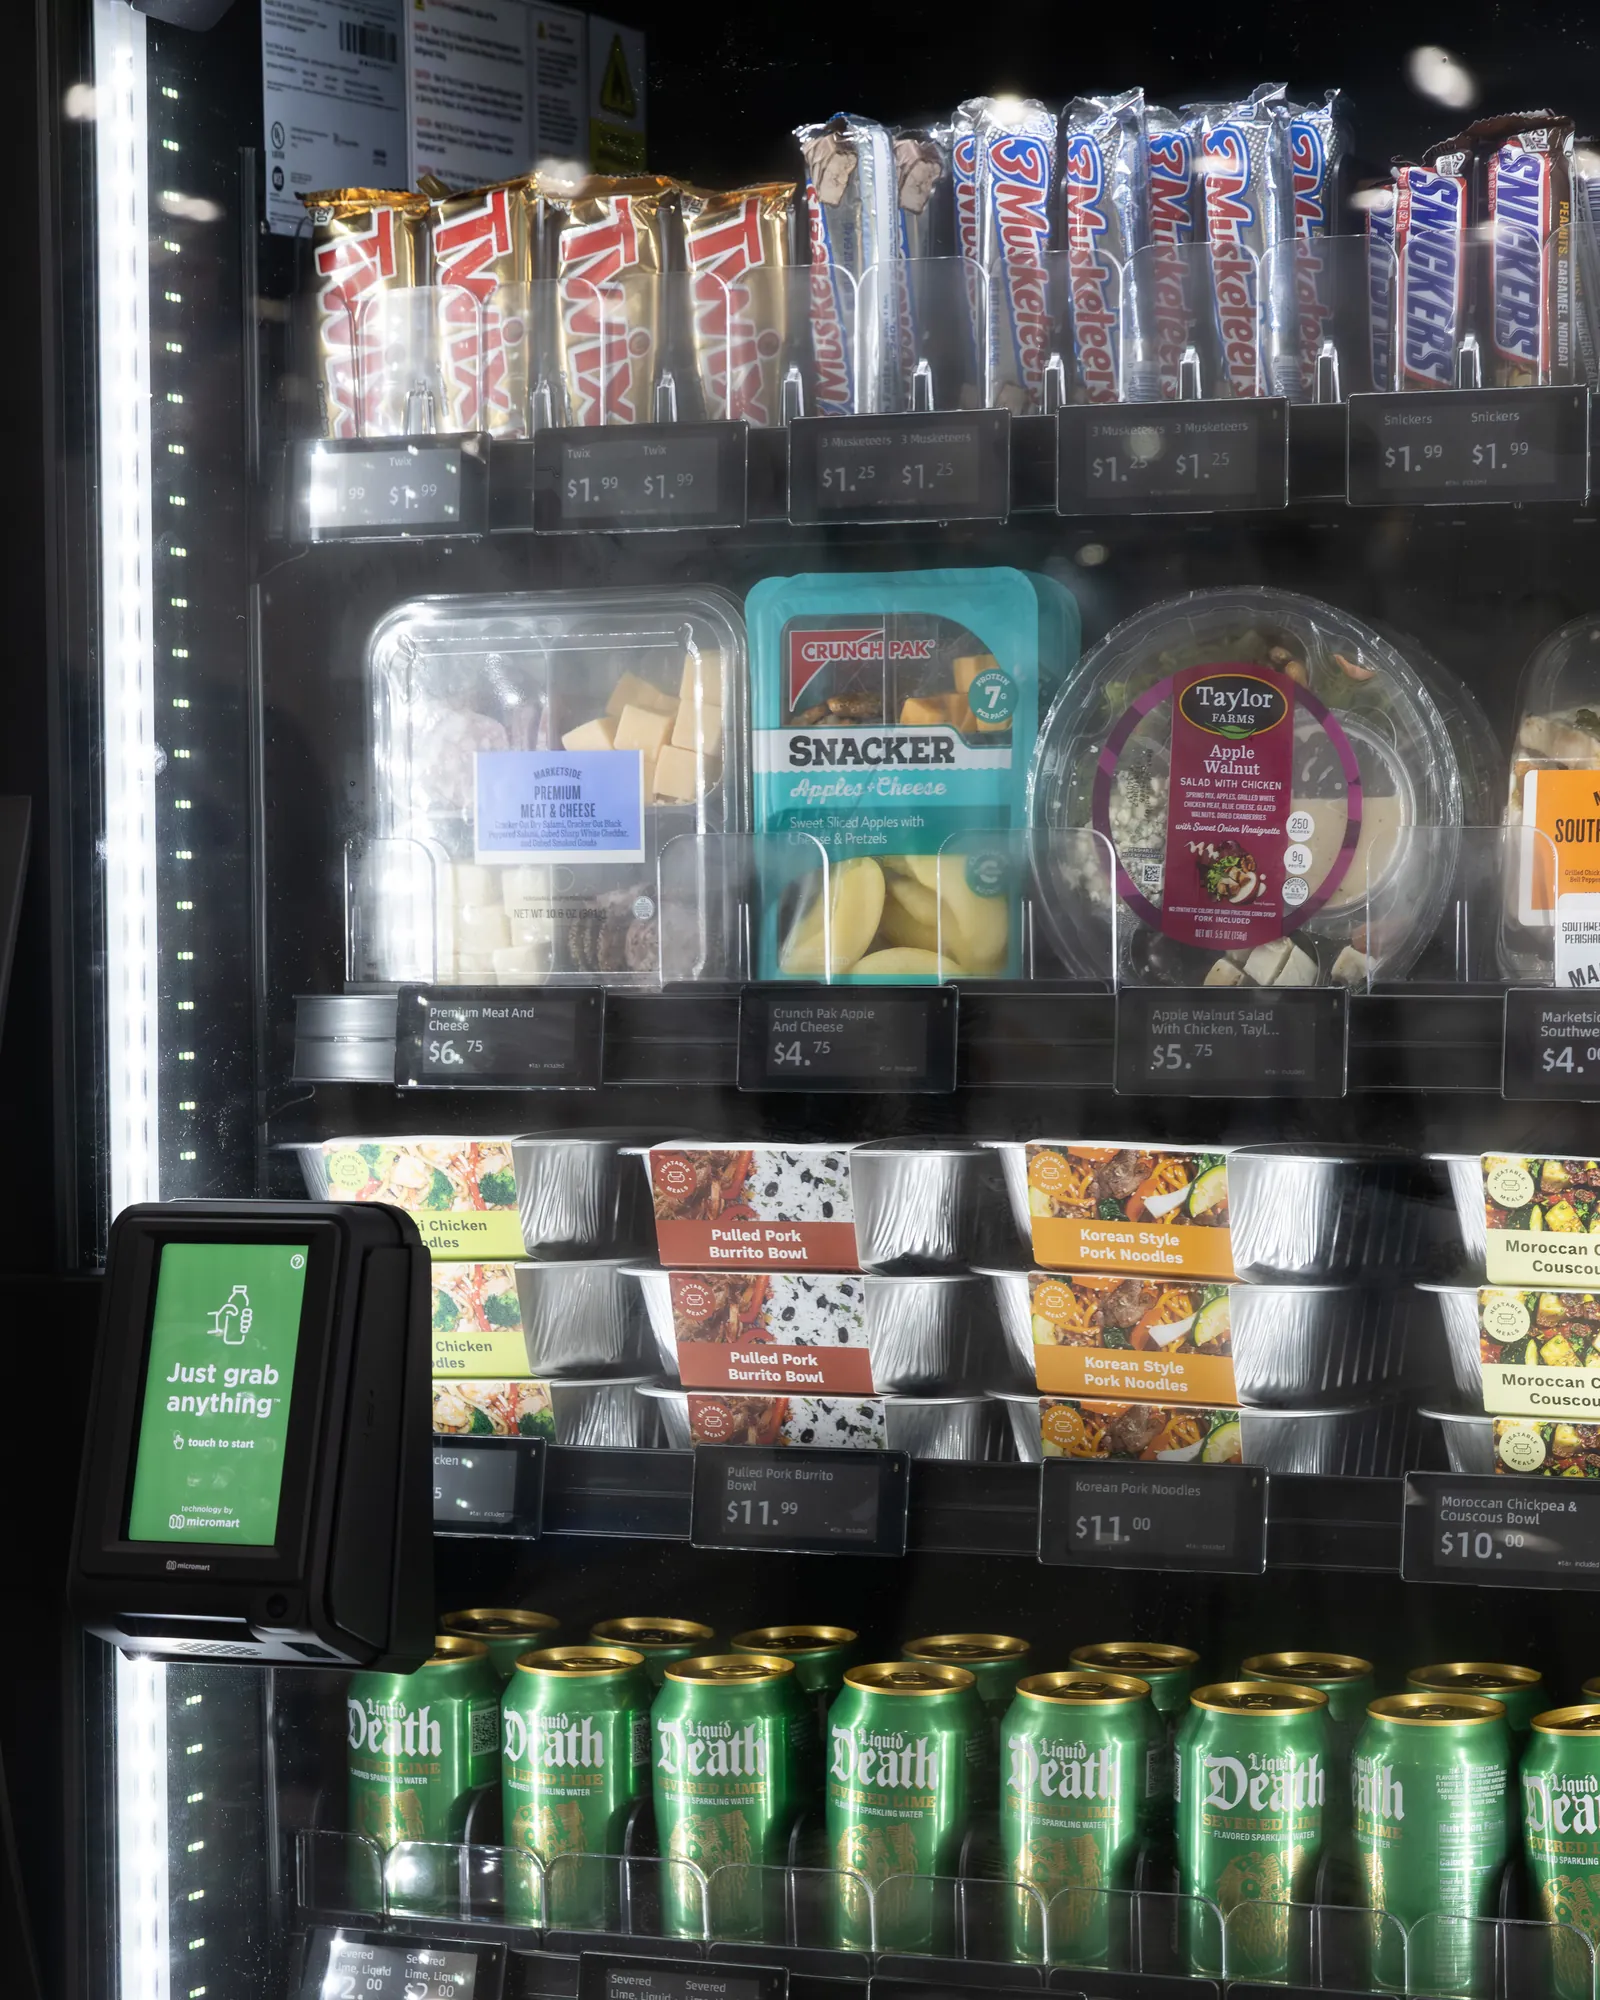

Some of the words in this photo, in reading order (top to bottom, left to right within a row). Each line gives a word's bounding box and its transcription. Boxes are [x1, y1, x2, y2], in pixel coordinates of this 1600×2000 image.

[990, 140, 1044, 184] 3
[1496, 149, 1542, 361] SNICKERS
[1405, 169, 1460, 388] SNICKERS
[994, 183, 1052, 400] Musketeers
[1067, 185, 1120, 400] Musketeers
[1557, 321, 1569, 368] NOUGAT
[1384, 413, 1433, 426] Snickers
[1471, 411, 1520, 423] Snickers
[1101, 426, 1165, 437] Musketeers
[1175, 423, 1182, 434] 3
[1184, 422, 1249, 433] Musketeers
[831, 436, 892, 448] Musketeers
[901, 434, 907, 444] 3
[910, 432, 972, 444] Musketeers
[567, 448, 592, 459] Twix
[643, 445, 667, 456] Twix
[388, 457, 413, 468] Twix
[802, 640, 883, 662] CRUNCH
[976, 673, 1010, 687] PROTEIN
[1196, 686, 1273, 712] Taylor
[1211, 713, 1255, 724] FARMS
[789, 735, 955, 767] SNACKER
[1209, 744, 1255, 761] Apple
[533, 766, 583, 780] MARKETSIDE
[1203, 759, 1260, 776] Walnut
[790, 777, 864, 804] Apples
[876, 776, 947, 797] Cheese
[1180, 777, 1211, 787] SALAD
[1214, 779, 1238, 788] WITH
[1241, 780, 1282, 790] CHICKEN
[534, 785, 581, 801] PREMIUM
[520, 803, 547, 819] MEAT
[550, 803, 557, 818] &
[559, 802, 596, 818] CHEESE
[790, 817, 824, 829] Sweet
[827, 816, 859, 828] Sliced
[861, 816, 899, 832] Apples
[901, 815, 925, 828] with
[1175, 822, 1192, 831] with
[1192, 821, 1217, 832] Sweet
[1217, 823, 1240, 833] Onion
[1241, 824, 1281, 837] Vinaigrette
[1291, 817, 1309, 830] 250
[834, 833, 843, 845] &
[845, 832, 888, 845] Pretzels
[514, 908, 529, 919] NET
[1215, 916, 1251, 925] INCLUDED
[430, 1007, 479, 1018] Premium
[482, 1007, 510, 1018] Meat
[511, 1007, 535, 1018] And
[773, 1008, 813, 1019] Crunch
[816, 1008, 838, 1019] Pak
[840, 1008, 875, 1021] Apple
[1152, 1009, 1189, 1022] Apple
[1192, 1009, 1235, 1021] Walnut
[1238, 1009, 1273, 1021] Salad
[428, 1020, 470, 1031] Cheese
[772, 1021, 798, 1033] And
[800, 1021, 845, 1033] Cheese
[1151, 1023, 1181, 1035] With
[1183, 1023, 1238, 1036] Chicken,
[660, 1160, 691, 1174] HEATABLE
[1493, 1168, 1526, 1181] HEATABLE
[666, 1185, 689, 1193] MEALS
[429, 1219, 488, 1231] Chicken
[711, 1228, 760, 1241] Pulled
[765, 1229, 802, 1242] Pork
[1080, 1228, 1135, 1244] Korean
[1139, 1232, 1180, 1249] Style
[709, 1246, 764, 1259] Burrito
[768, 1247, 808, 1260] Bowl
[1079, 1246, 1117, 1260] Pork
[1120, 1249, 1184, 1264] Noodles
[1505, 1239, 1588, 1256] Moroccan
[1495, 1328, 1520, 1336] MEALS
[435, 1340, 493, 1352] Chicken
[730, 1352, 779, 1365] Pulled
[782, 1353, 818, 1366] Pork
[1084, 1356, 1139, 1371] Korean
[1143, 1360, 1185, 1377] Style
[166, 1362, 217, 1384] Just
[223, 1363, 279, 1388] grab
[728, 1368, 782, 1382] Burrito
[786, 1370, 825, 1384] Bowl
[1084, 1373, 1121, 1387] Pork
[1124, 1376, 1189, 1392] Noodles
[1502, 1373, 1585, 1389] Moroccan
[188, 1438, 216, 1448] touch
[219, 1438, 229, 1448] to
[231, 1439, 255, 1449] start
[1511, 1457, 1535, 1466] MEALS
[727, 1466, 763, 1478] Pulled
[766, 1468, 792, 1480] Pork
[795, 1470, 834, 1481] Burrito
[727, 1480, 757, 1491] Bowl
[1075, 1480, 1118, 1493] Korean
[1121, 1482, 1149, 1494] Pork
[1151, 1484, 1201, 1497] Noodles
[181, 1505, 222, 1515] technology
[223, 1505, 234, 1515] by
[1441, 1496, 1503, 1509] Moroccan
[1507, 1498, 1565, 1513] Chickpea
[1568, 1501, 1578, 1512] &
[186, 1516, 240, 1528] micromart
[1440, 1509, 1503, 1523] Couscous
[1507, 1512, 1540, 1525] Bowl
[177, 1562, 210, 1571] micromart
[347, 1695, 443, 1757] Death
[684, 1719, 732, 1740] Liquid
[858, 1727, 904, 1750] Liquid
[657, 1717, 768, 1777] Death
[1039, 1737, 1087, 1760] Liquid
[830, 1723, 939, 1791] Death
[1006, 1735, 1121, 1800] Death
[403, 1777, 428, 1785] WATER
[723, 1782, 767, 1795] LIME
[1202, 1752, 1326, 1813] Death
[1550, 1773, 1598, 1796] Liquid
[566, 1788, 591, 1797] WATER
[691, 1797, 730, 1806] SPARKLING
[730, 1797, 755, 1805] WATER
[893, 1795, 937, 1809] LIME
[860, 1806, 898, 1818] SPARKLING
[898, 1810, 924, 1819] WATER
[1041, 1818, 1081, 1829] SPARKLING
[1081, 1821, 1107, 1829] WATER
[1202, 1813, 1283, 1831] SEVERED
[1213, 1830, 1250, 1841] FLAVORED
[1559, 1856, 1599, 1866] SPARKLING
[362, 1965, 392, 1977] Liquid
[405, 1968, 430, 1982] Lime,
[611, 1973, 652, 1987] Severed
[685, 1980, 727, 1993] Severed
